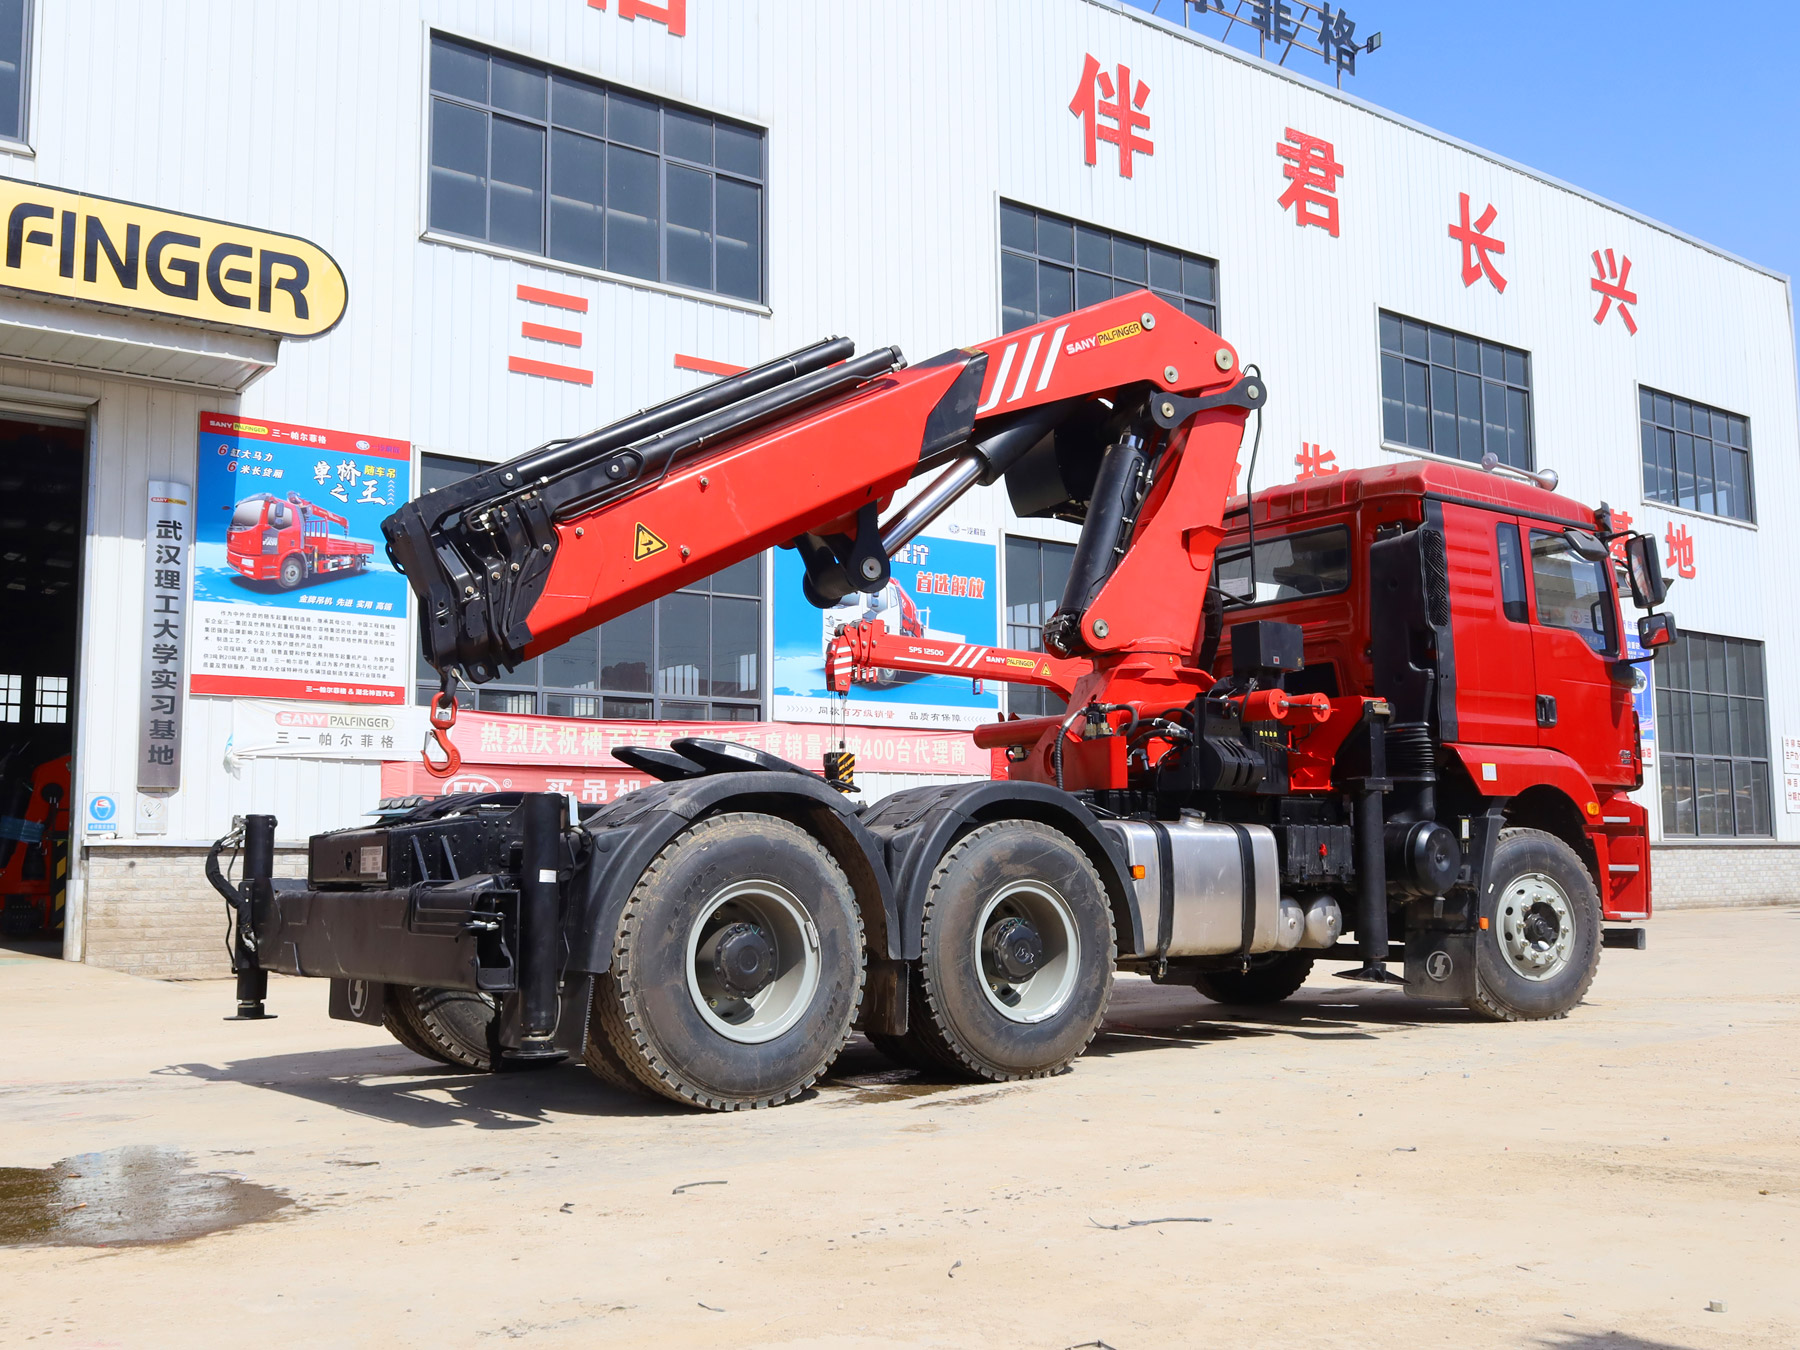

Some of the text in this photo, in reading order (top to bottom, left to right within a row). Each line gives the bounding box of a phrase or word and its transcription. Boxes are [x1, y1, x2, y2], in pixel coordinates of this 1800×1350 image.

[1070, 52, 1637, 335] 伴君长兴
[6, 203, 309, 320] FINGER
[1066, 323, 1140, 355] SANY PALFINGER
[209, 420, 327, 444] SANY PALFINGER 三一帕尔菲格
[218, 444, 229, 455] 6
[227, 461, 238, 472] 6
[364, 465, 397, 479] 随车吊
[916, 571, 985, 599] 首选解放
[299, 595, 393, 611] 金牌吊机 先进 实用 高端
[148, 520, 183, 766] 武汉理工大学实习基地
[908, 646, 944, 656] SPS 12500
[985, 656, 1034, 667] SANY PALFINGER
[305, 685, 347, 695] 三一帕尔菲格
[280, 712, 390, 729] SANY PALFINGER
[909, 711, 962, 723] 品质有保障
[276, 732, 394, 750] 三一帕尔菲格
